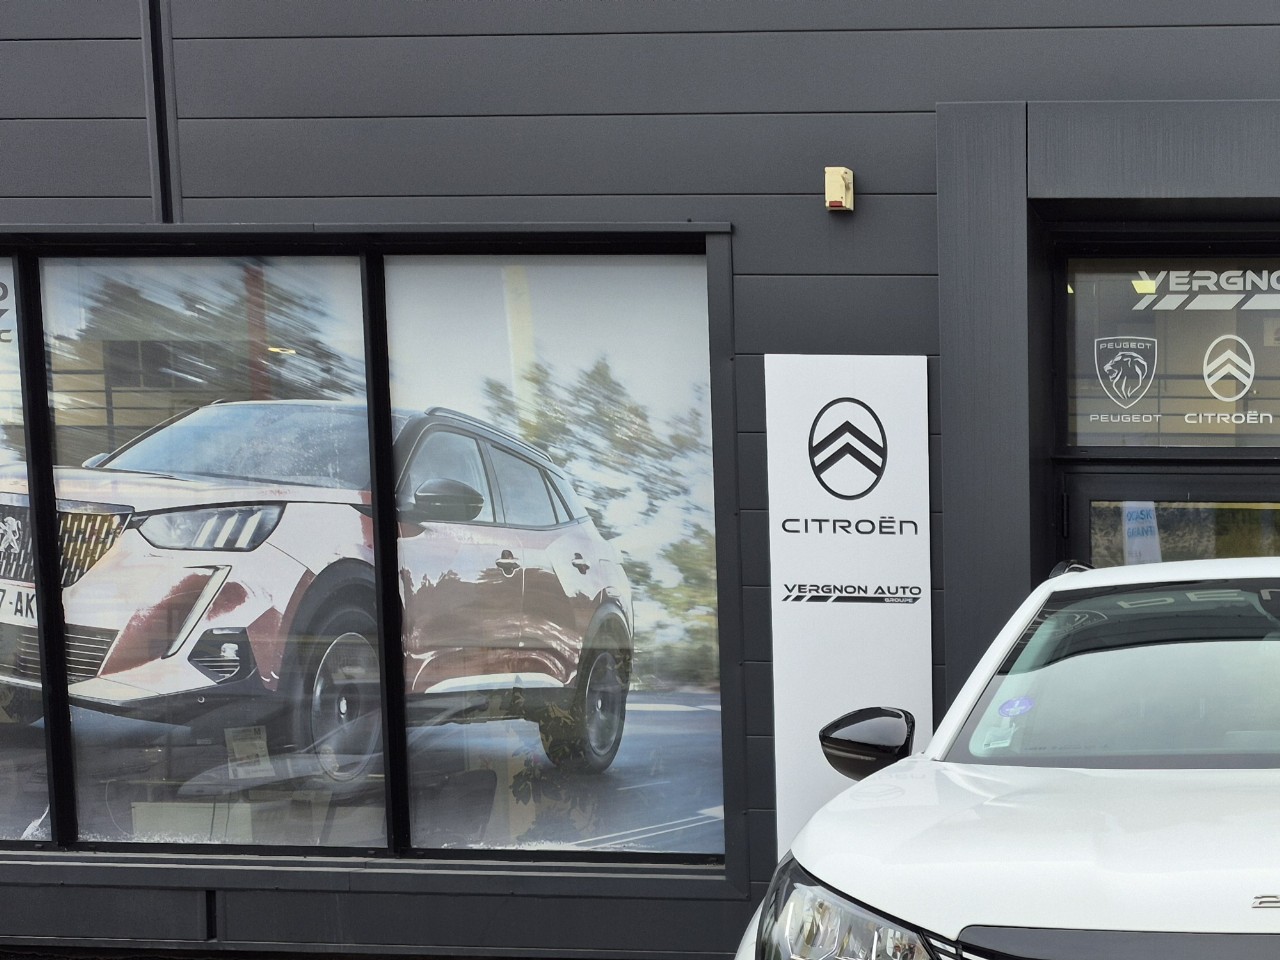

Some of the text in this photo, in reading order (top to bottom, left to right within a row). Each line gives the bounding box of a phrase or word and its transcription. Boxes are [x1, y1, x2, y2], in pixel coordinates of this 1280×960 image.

[1099, 341, 1152, 351] PEUGEOT
[1089, 413, 1162, 424] PEUGEOT
[783, 583, 922, 596] VERGNON AUTO
